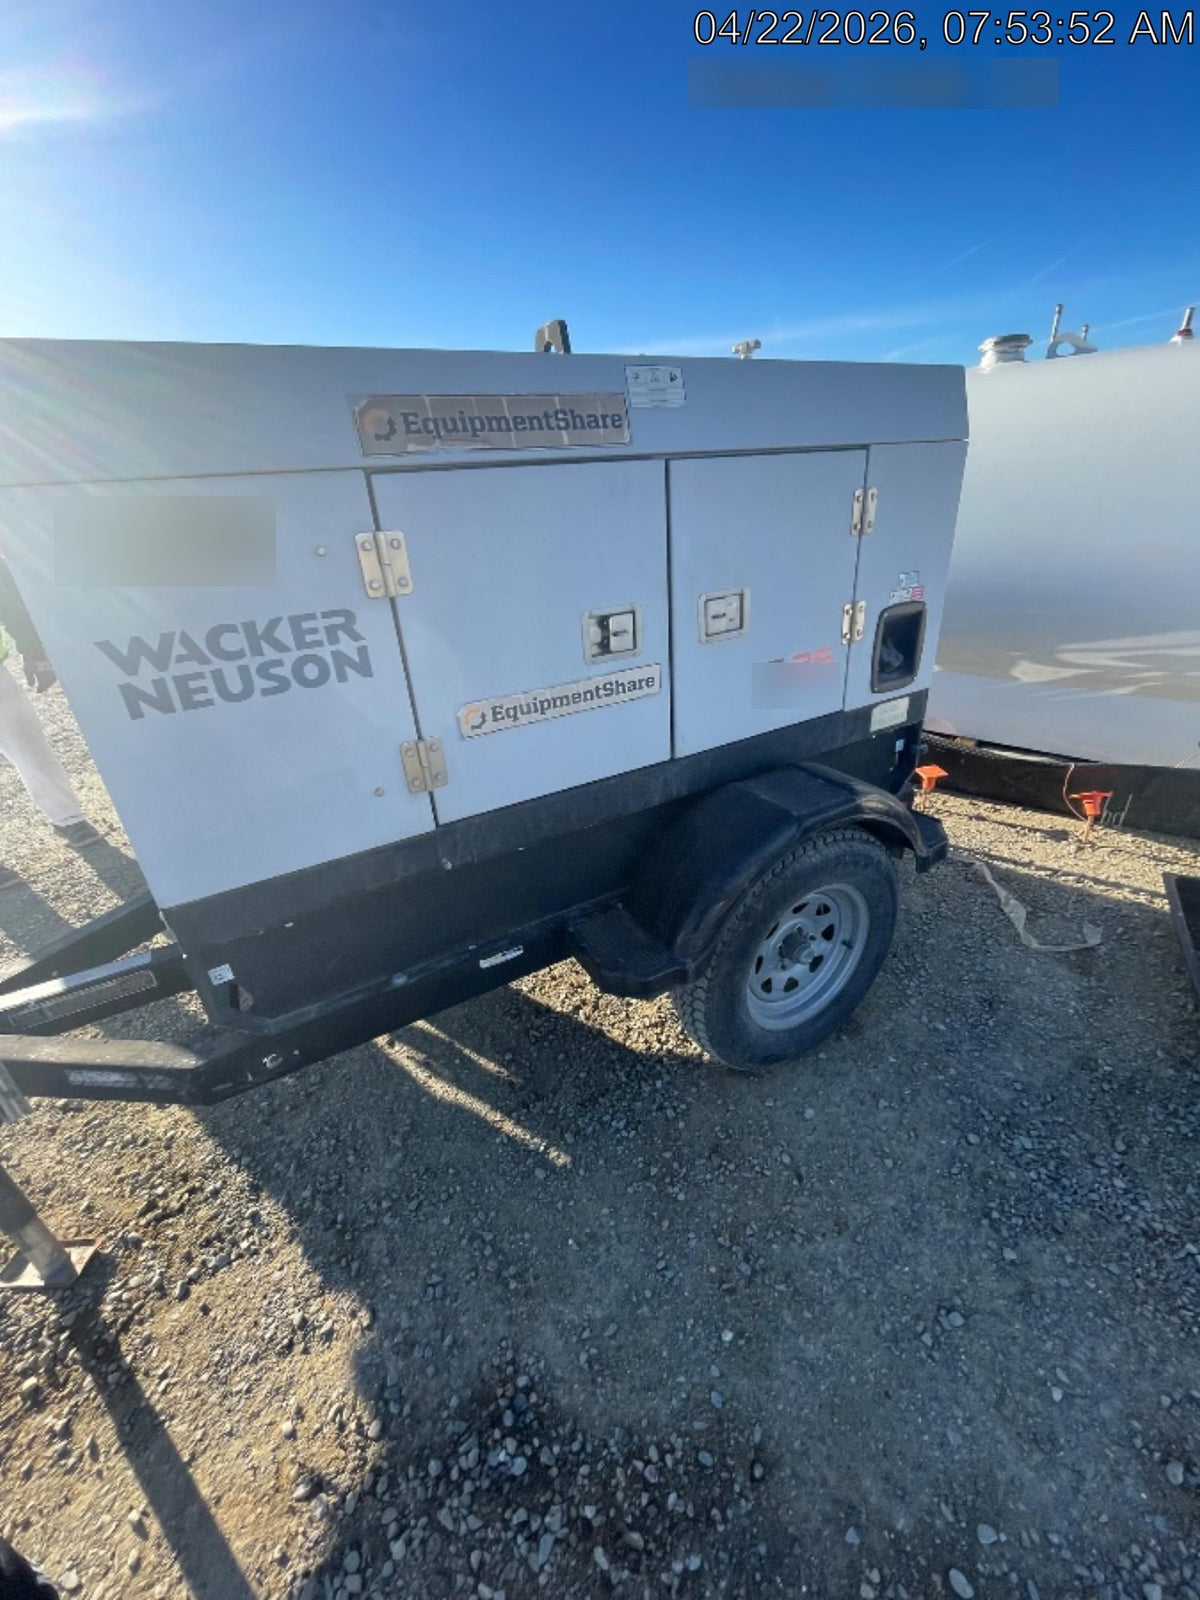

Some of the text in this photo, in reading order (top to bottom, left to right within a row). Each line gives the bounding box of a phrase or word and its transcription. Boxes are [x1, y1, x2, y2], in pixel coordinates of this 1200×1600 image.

[399, 408, 623, 439] EquipmentShare
[93, 608, 366, 677] WACKER
[117, 644, 374, 721] NEUSON
[490, 674, 655, 723] EquipmentShare
